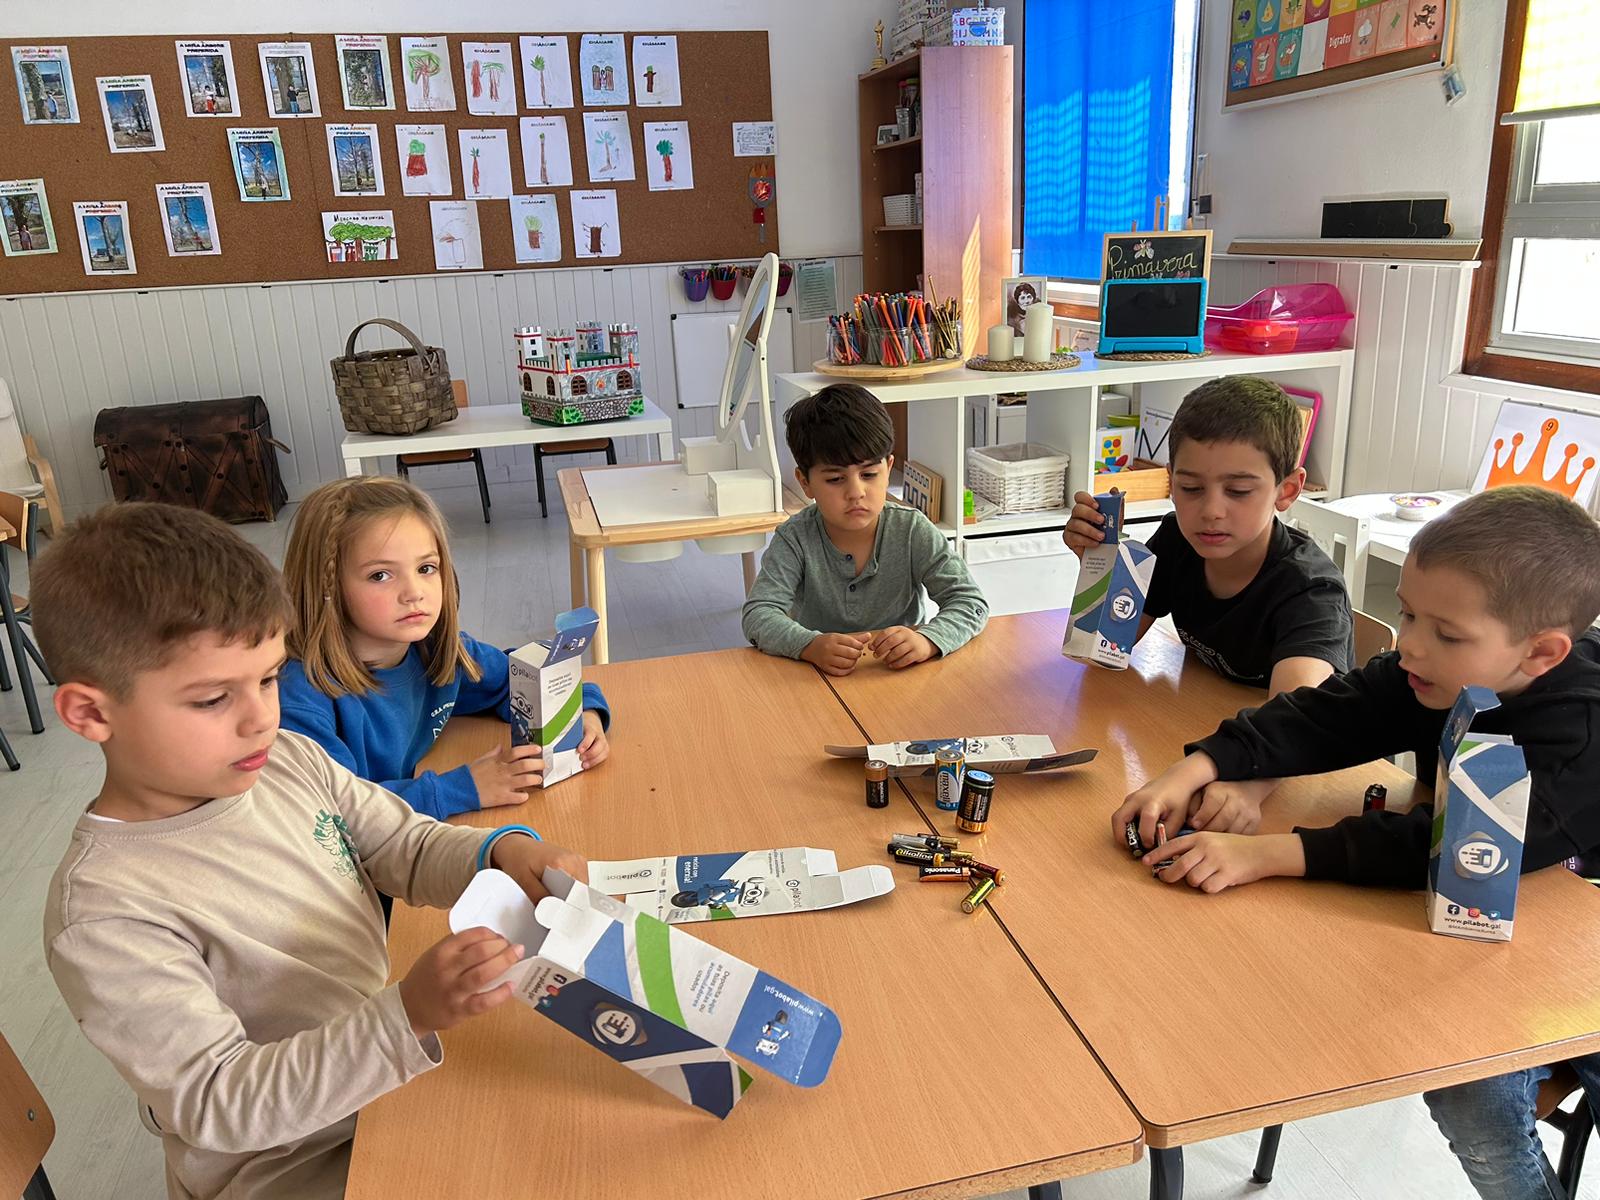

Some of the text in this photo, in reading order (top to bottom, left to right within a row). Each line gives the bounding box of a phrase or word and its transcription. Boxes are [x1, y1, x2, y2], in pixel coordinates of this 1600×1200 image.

[1546, 422, 1554, 431] 9
[941, 772, 950, 802] maxell
[1444, 917, 1501, 929] www.pilabot.gal
[764, 985, 815, 1016] www.pilabot.gal
